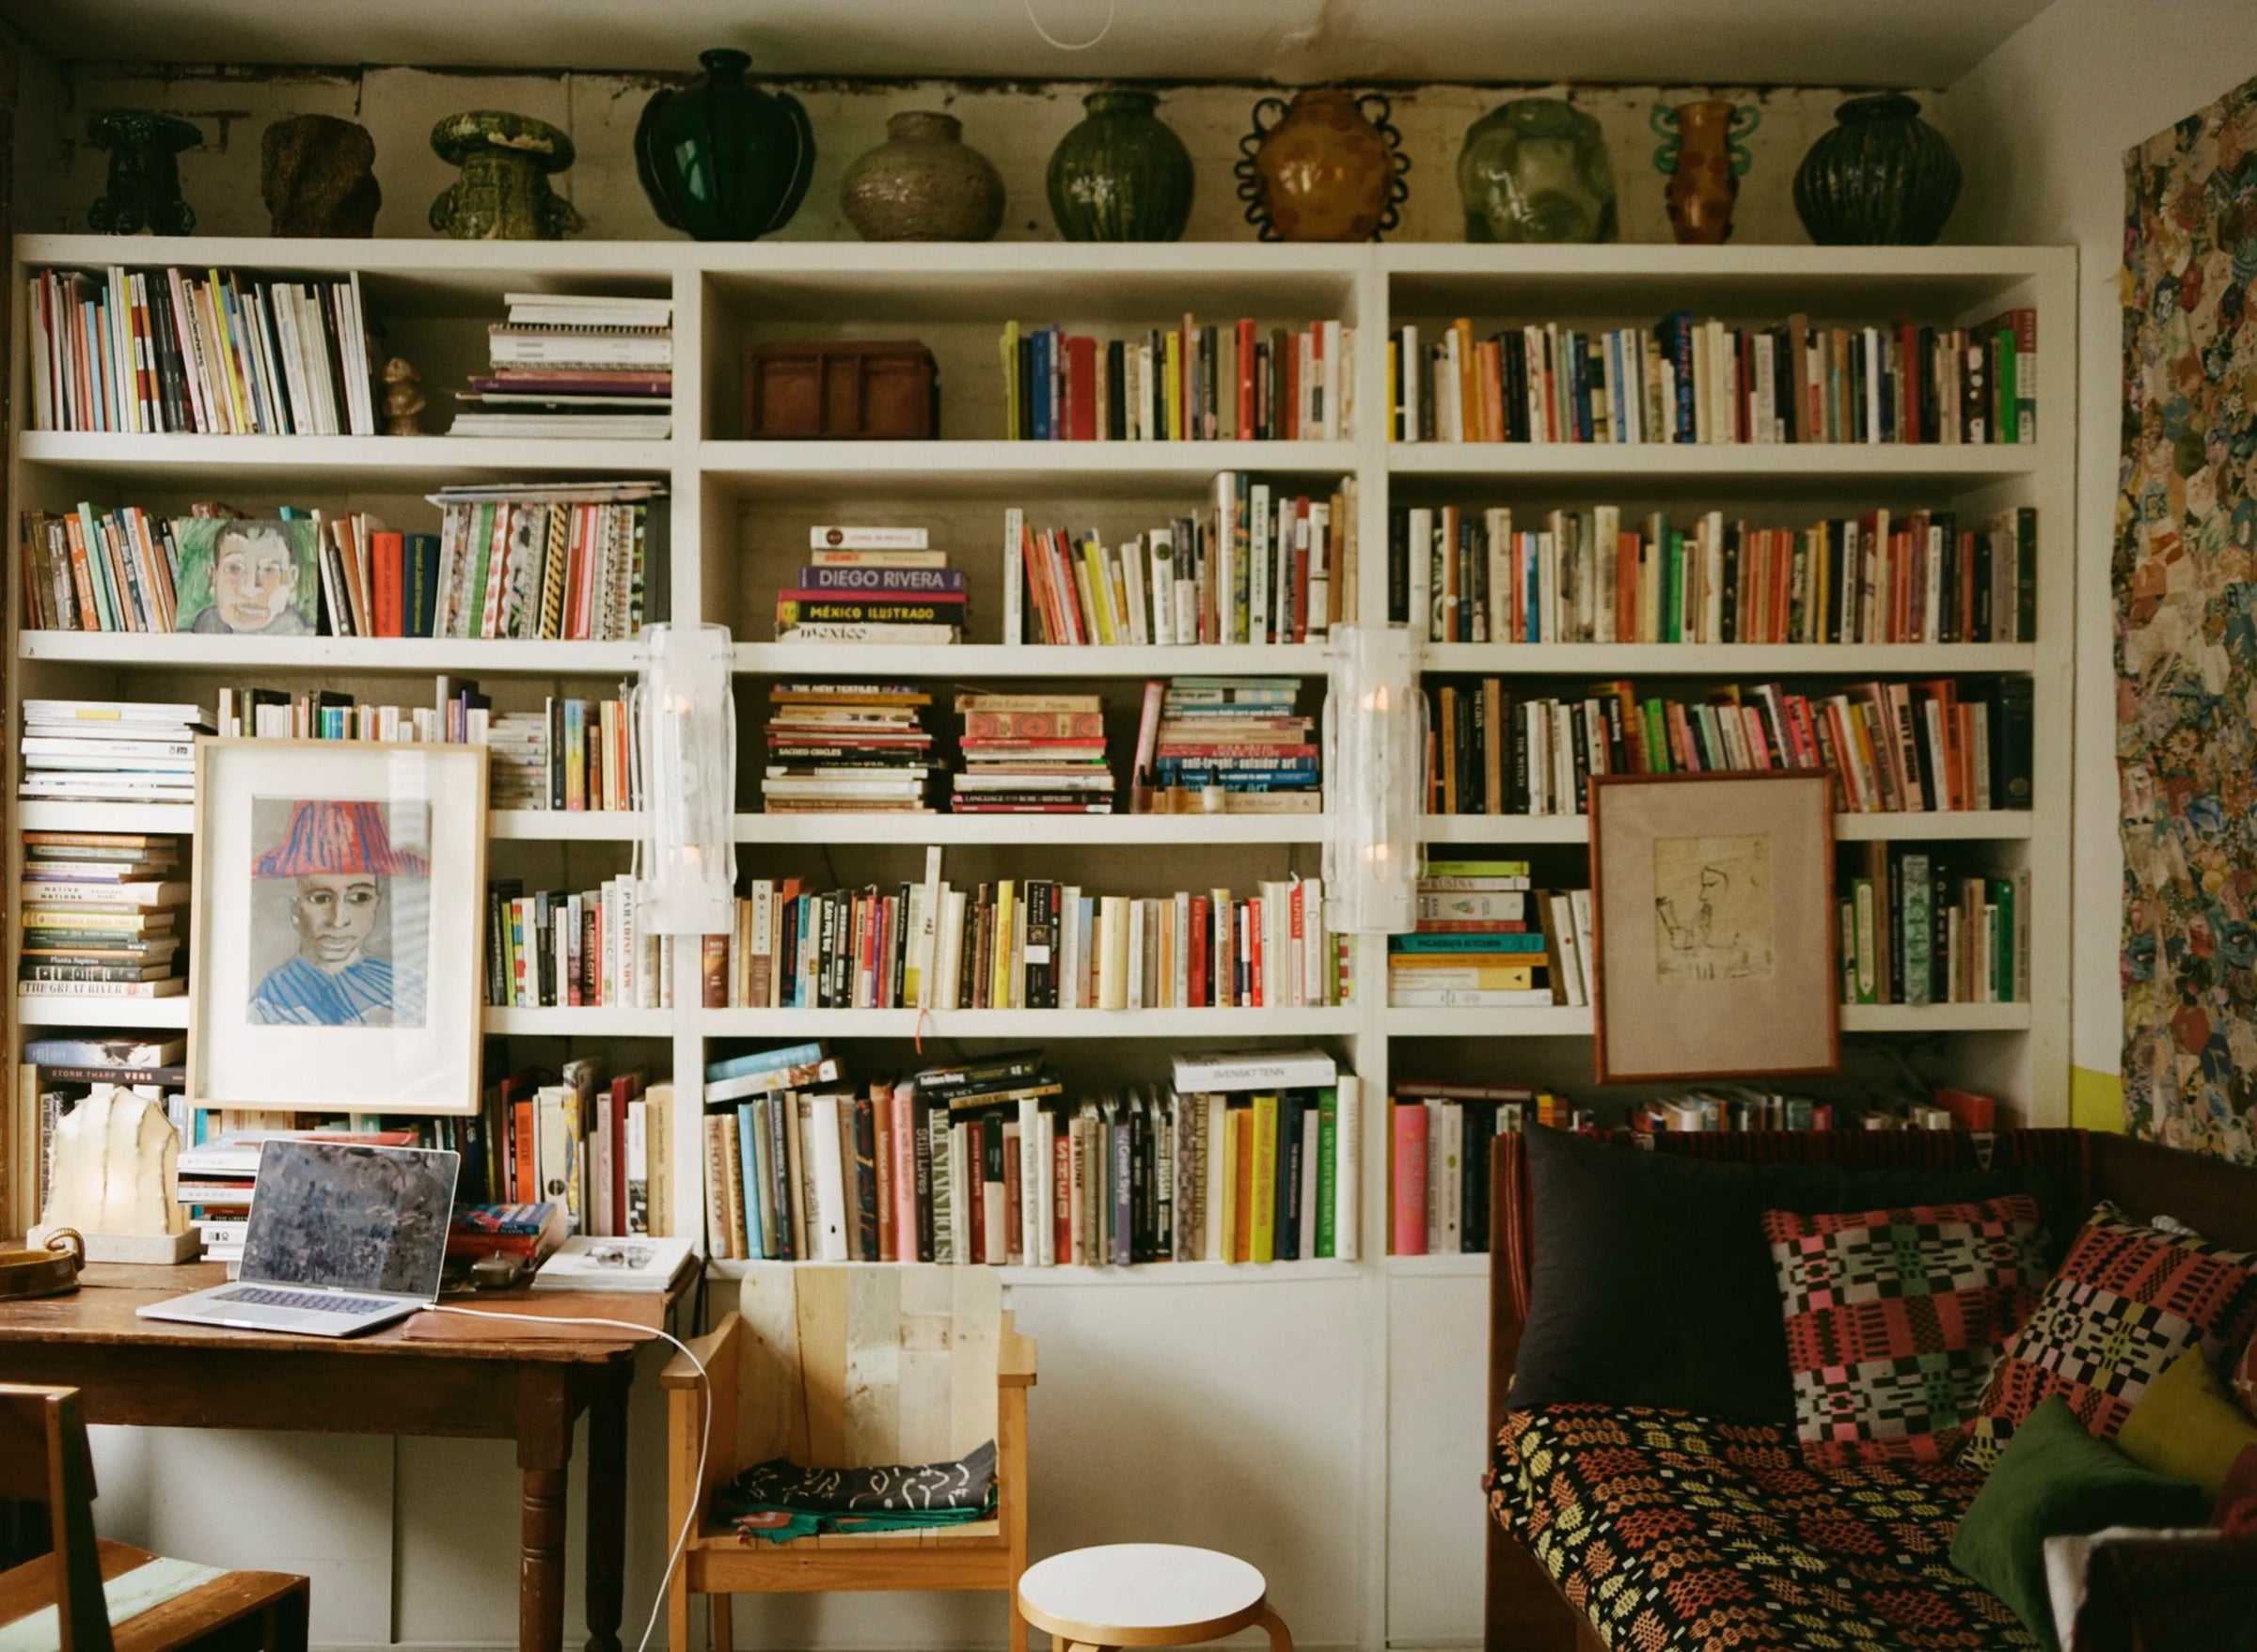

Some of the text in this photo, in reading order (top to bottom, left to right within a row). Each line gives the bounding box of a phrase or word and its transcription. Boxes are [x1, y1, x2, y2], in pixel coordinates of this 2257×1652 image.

[819, 571, 943, 588] DIEGO RIVERA
[810, 606, 935, 620] MÉXICO ILUSTRADO
[1282, 759, 1297, 769] art
[623, 892, 631, 955] PARADISE
[24, 983, 121, 994] THE GREAT RIVER
[51, 1070, 83, 1078] STORM
[710, 1148, 721, 1185] HOUSE
[917, 1128, 928, 1195] Still Lives
[933, 1109, 949, 1204] MOUNTAIN
[1057, 1141, 1068, 1219] SHED
[713, 1189, 723, 1222] BOOK
